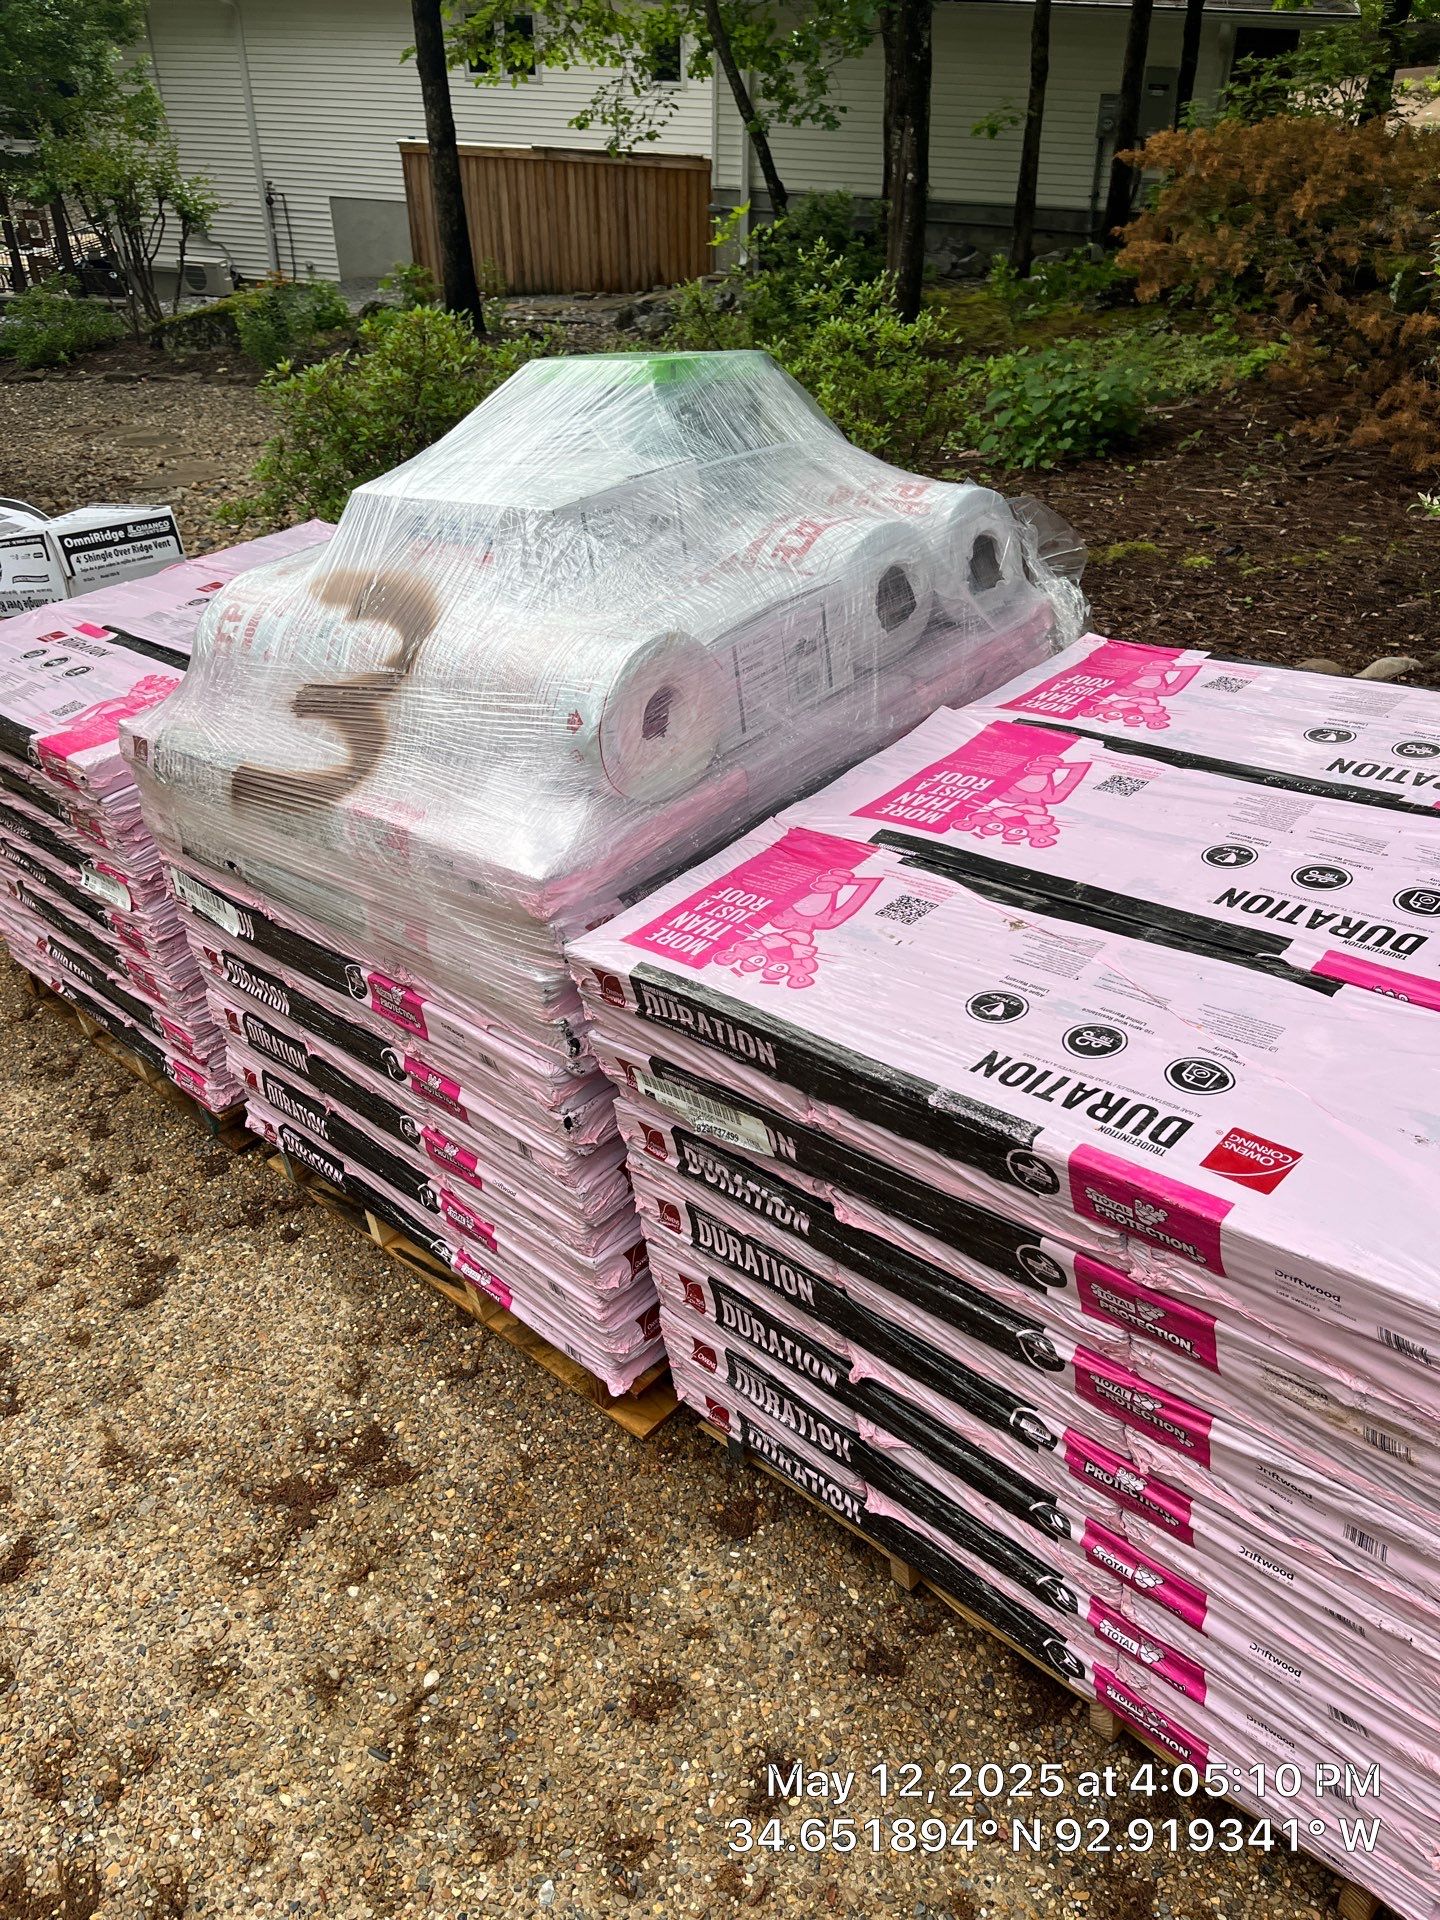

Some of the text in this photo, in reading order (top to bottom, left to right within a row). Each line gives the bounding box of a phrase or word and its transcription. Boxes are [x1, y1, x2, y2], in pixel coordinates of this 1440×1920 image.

[63, 528, 126, 549] OmniRidge
[83, 550, 114, 566] Shingle
[114, 546, 131, 558] Over
[132, 542, 153, 556] Ridge
[153, 538, 171, 549] Vent
[1060, 673, 1116, 688] ROOF
[1067, 684, 1104, 700] JUST
[1024, 698, 1070, 716] MORE
[1031, 688, 1086, 707] THAN
[931, 770, 994, 791] ROOF
[1325, 757, 1440, 791] ATION
[894, 790, 957, 813] THAN
[931, 786, 980, 808] JUST
[880, 804, 940, 824] MORE
[708, 903, 756, 925] JUST
[713, 886, 771, 912] ROOF
[668, 910, 731, 942] THAN
[1213, 887, 1430, 957] DURATION
[644, 927, 714, 957] MORE
[1342, 938, 1407, 960] TRUDEFINITION
[227, 960, 290, 1016] DURATION
[641, 990, 777, 1069] DURATION
[246, 1021, 310, 1075] DURATION
[266, 1083, 329, 1140] DURATION
[968, 1050, 1201, 1150] DURATION
[1098, 1125, 1167, 1157] TRUDEFINITION
[1222, 1139, 1276, 1167] OWENS
[1229, 1133, 1294, 1164] CORNING
[684, 1146, 812, 1237] DURATION
[1093, 1195, 1133, 1218] TOTAL
[450, 1209, 467, 1226] TOTAL
[1095, 1203, 1197, 1255] PROTECTION
[698, 1217, 816, 1306] DURATION
[1275, 1268, 1341, 1302] Driftwood
[1100, 1291, 1135, 1315] TOTAL
[1098, 1299, 1194, 1352] PROTECTION
[722, 1303, 840, 1390] DURATION
[735, 1364, 853, 1464] DURATION
[1095, 1386, 1189, 1439] PROTECTION
[1257, 1464, 1314, 1500] Driftwood
[1099, 1554, 1131, 1578] TOTAL
[1239, 1544, 1295, 1582] Driftwood
[1106, 1628, 1137, 1653] TOTAL
[1250, 1642, 1302, 1679] Driftwood
[1113, 1691, 1144, 1717] TOTAL
[1246, 1713, 1296, 1750] Driftwood
